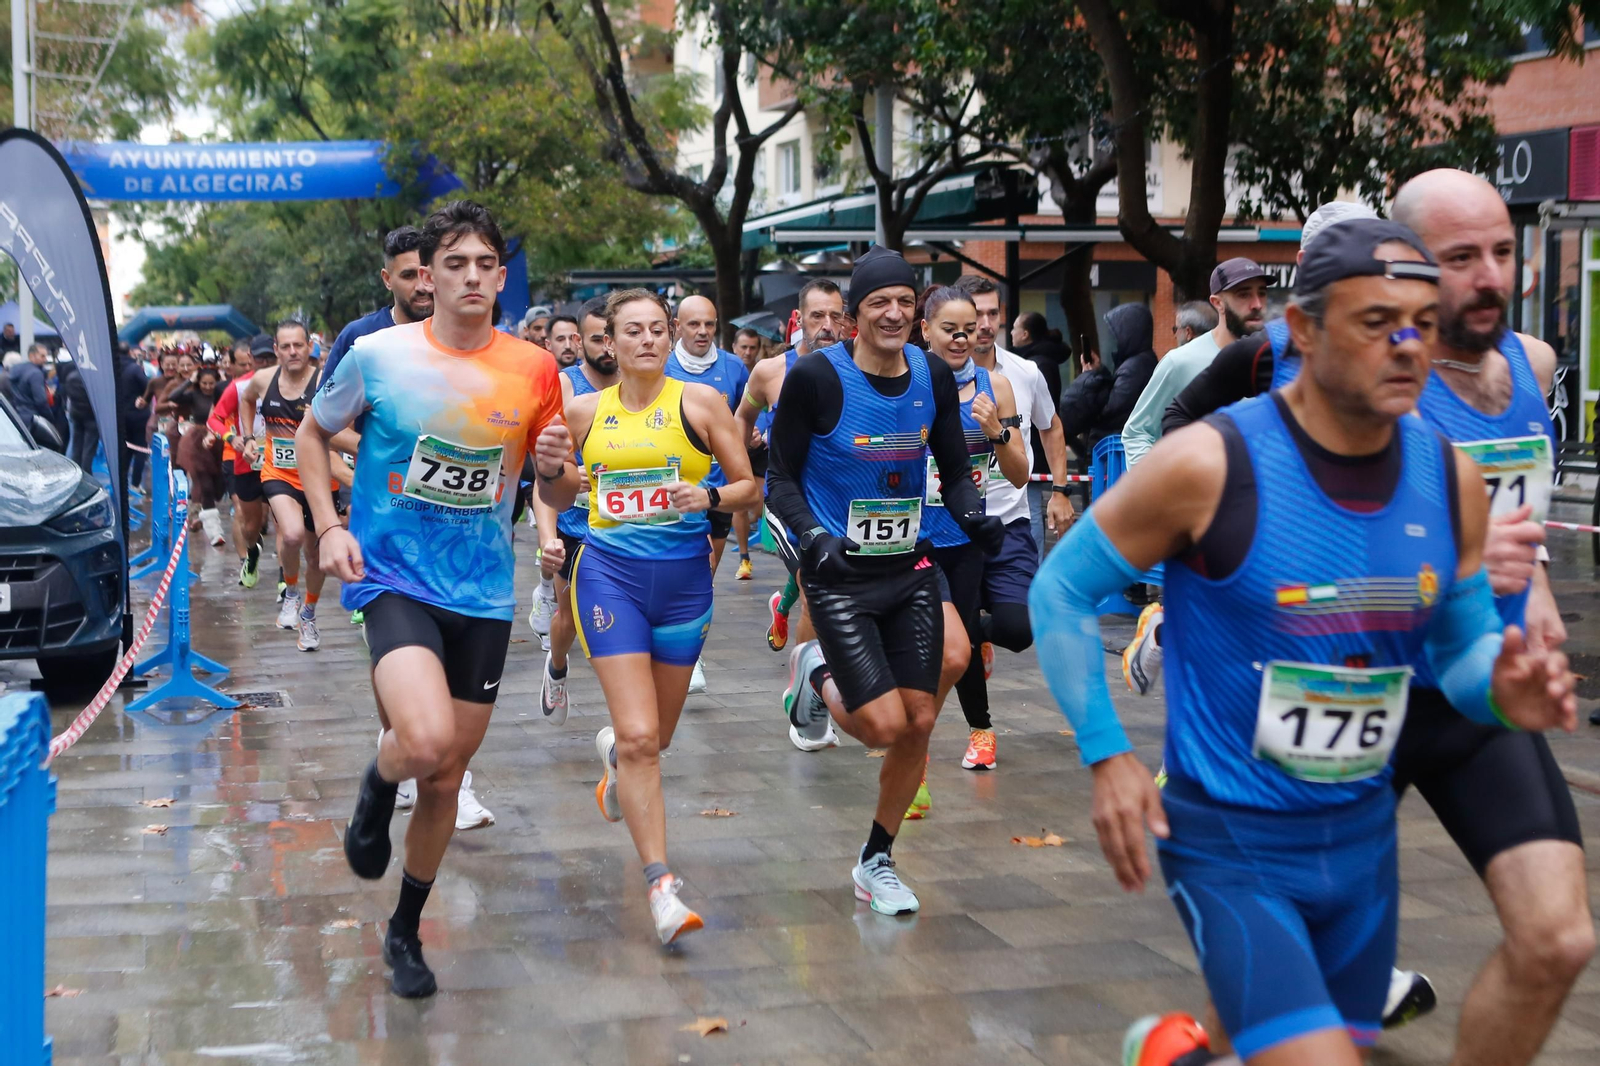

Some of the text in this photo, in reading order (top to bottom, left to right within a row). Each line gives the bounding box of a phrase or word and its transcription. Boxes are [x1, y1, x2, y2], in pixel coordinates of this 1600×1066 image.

[109, 148, 317, 170] AYUNTAMIENTO
[124, 172, 304, 193] DE ALGECIRAS
[487, 417, 521, 427] TRIATLON
[419, 456, 490, 493] 738
[390, 497, 430, 513] GROUP
[605, 488, 671, 515] 614
[450, 517, 471, 525] TEAM
[856, 517, 911, 542] 151
[1280, 706, 1388, 750] 176
